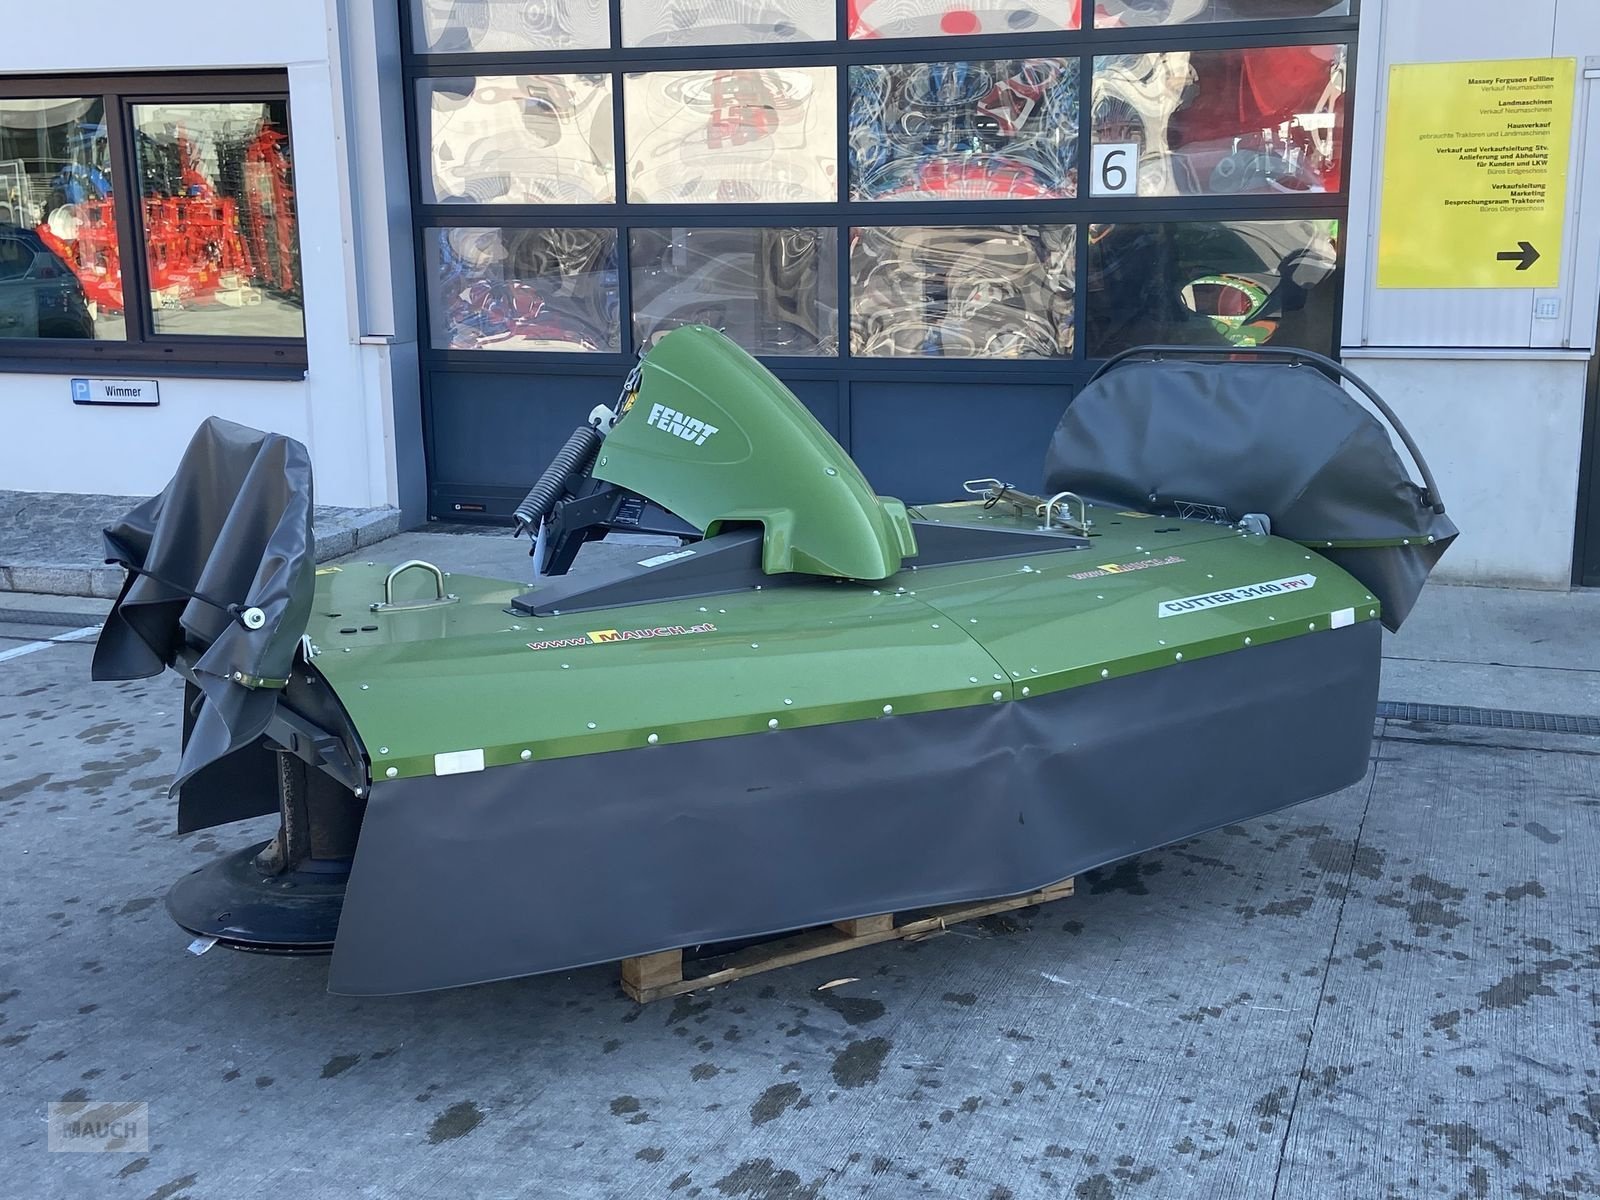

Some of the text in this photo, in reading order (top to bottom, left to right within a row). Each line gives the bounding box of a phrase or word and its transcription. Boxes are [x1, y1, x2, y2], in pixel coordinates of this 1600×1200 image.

[1506, 83, 1554, 91] Neumaschinen
[1505, 106, 1553, 114] Neumaschinen
[1507, 121, 1551, 129] Hausverkauf
[1419, 133, 1454, 141] gebrauchte
[1500, 129, 1551, 137] Landmaschinen
[1479, 144, 1533, 153] Verkaufsleitung
[1515, 152, 1549, 160] Abholung
[1101, 149, 1128, 191] 6
[1507, 168, 1548, 176] Erdgeschoss
[1510, 190, 1546, 198] Marketing
[1444, 199, 1510, 207] Besprechungsraum
[1500, 205, 1545, 213] Obergeschoss
[75, 382, 142, 400] P Wimmer
[647, 402, 720, 446] FENDT
[1164, 579, 1309, 612] CUTTER 3140 FPV
